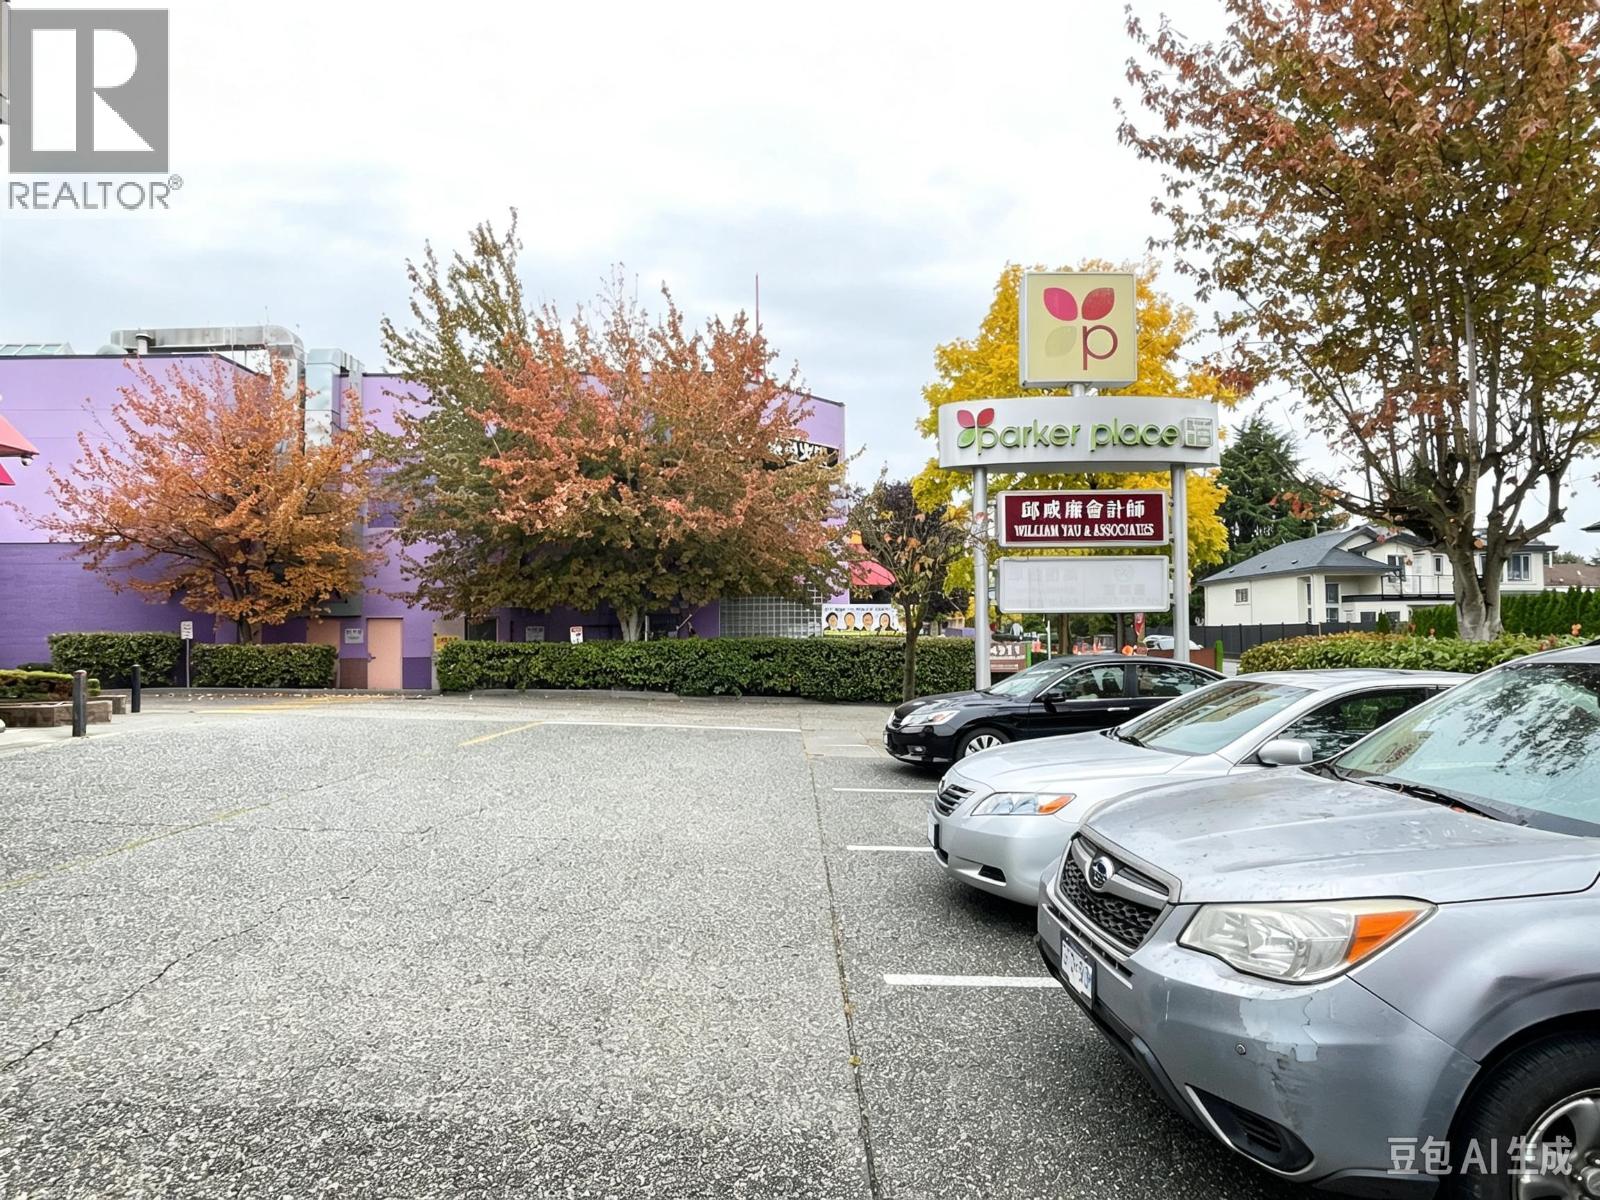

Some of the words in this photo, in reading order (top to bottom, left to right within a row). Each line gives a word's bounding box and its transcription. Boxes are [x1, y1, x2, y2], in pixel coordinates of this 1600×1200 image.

[977, 418, 1081, 456] parker
[1090, 418, 1180, 452] place
[1014, 524, 1059, 537] WILLIAM
[1061, 524, 1082, 537] YAU
